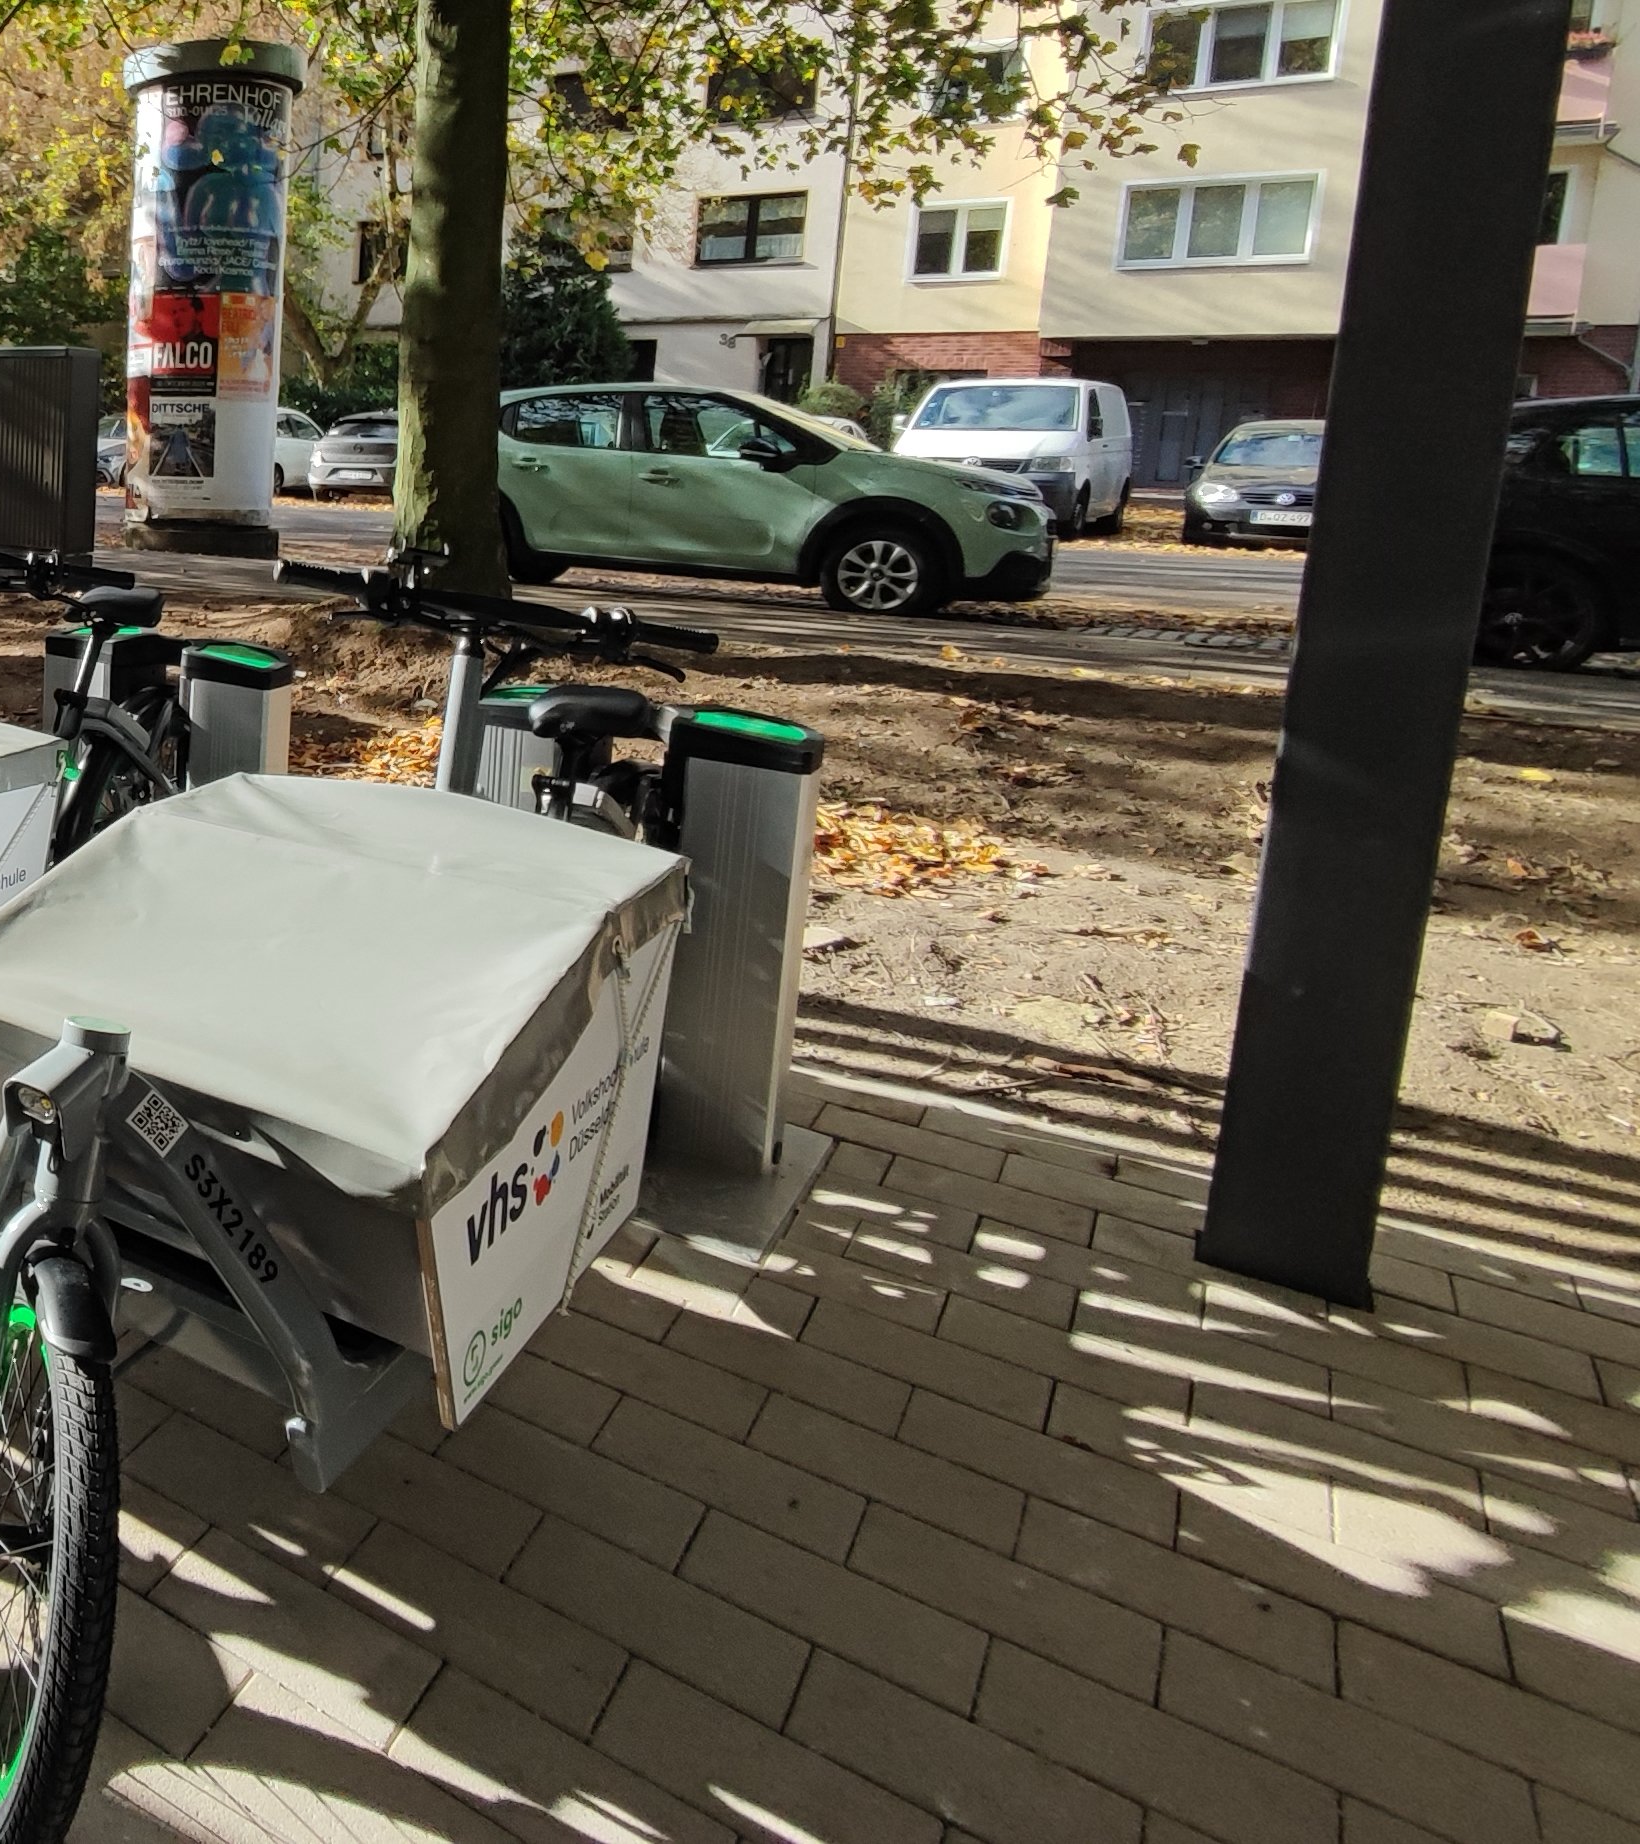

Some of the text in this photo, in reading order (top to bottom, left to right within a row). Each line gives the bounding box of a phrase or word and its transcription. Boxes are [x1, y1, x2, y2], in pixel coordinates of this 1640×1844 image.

[165, 83, 282, 110] EHRENHOF
[153, 341, 213, 369] FALCO
[152, 403, 210, 413] DITTSCHE
[184, 1153, 279, 1283] S3X2189
[467, 1162, 529, 1267] vhs
[490, 1297, 523, 1347] sigo
